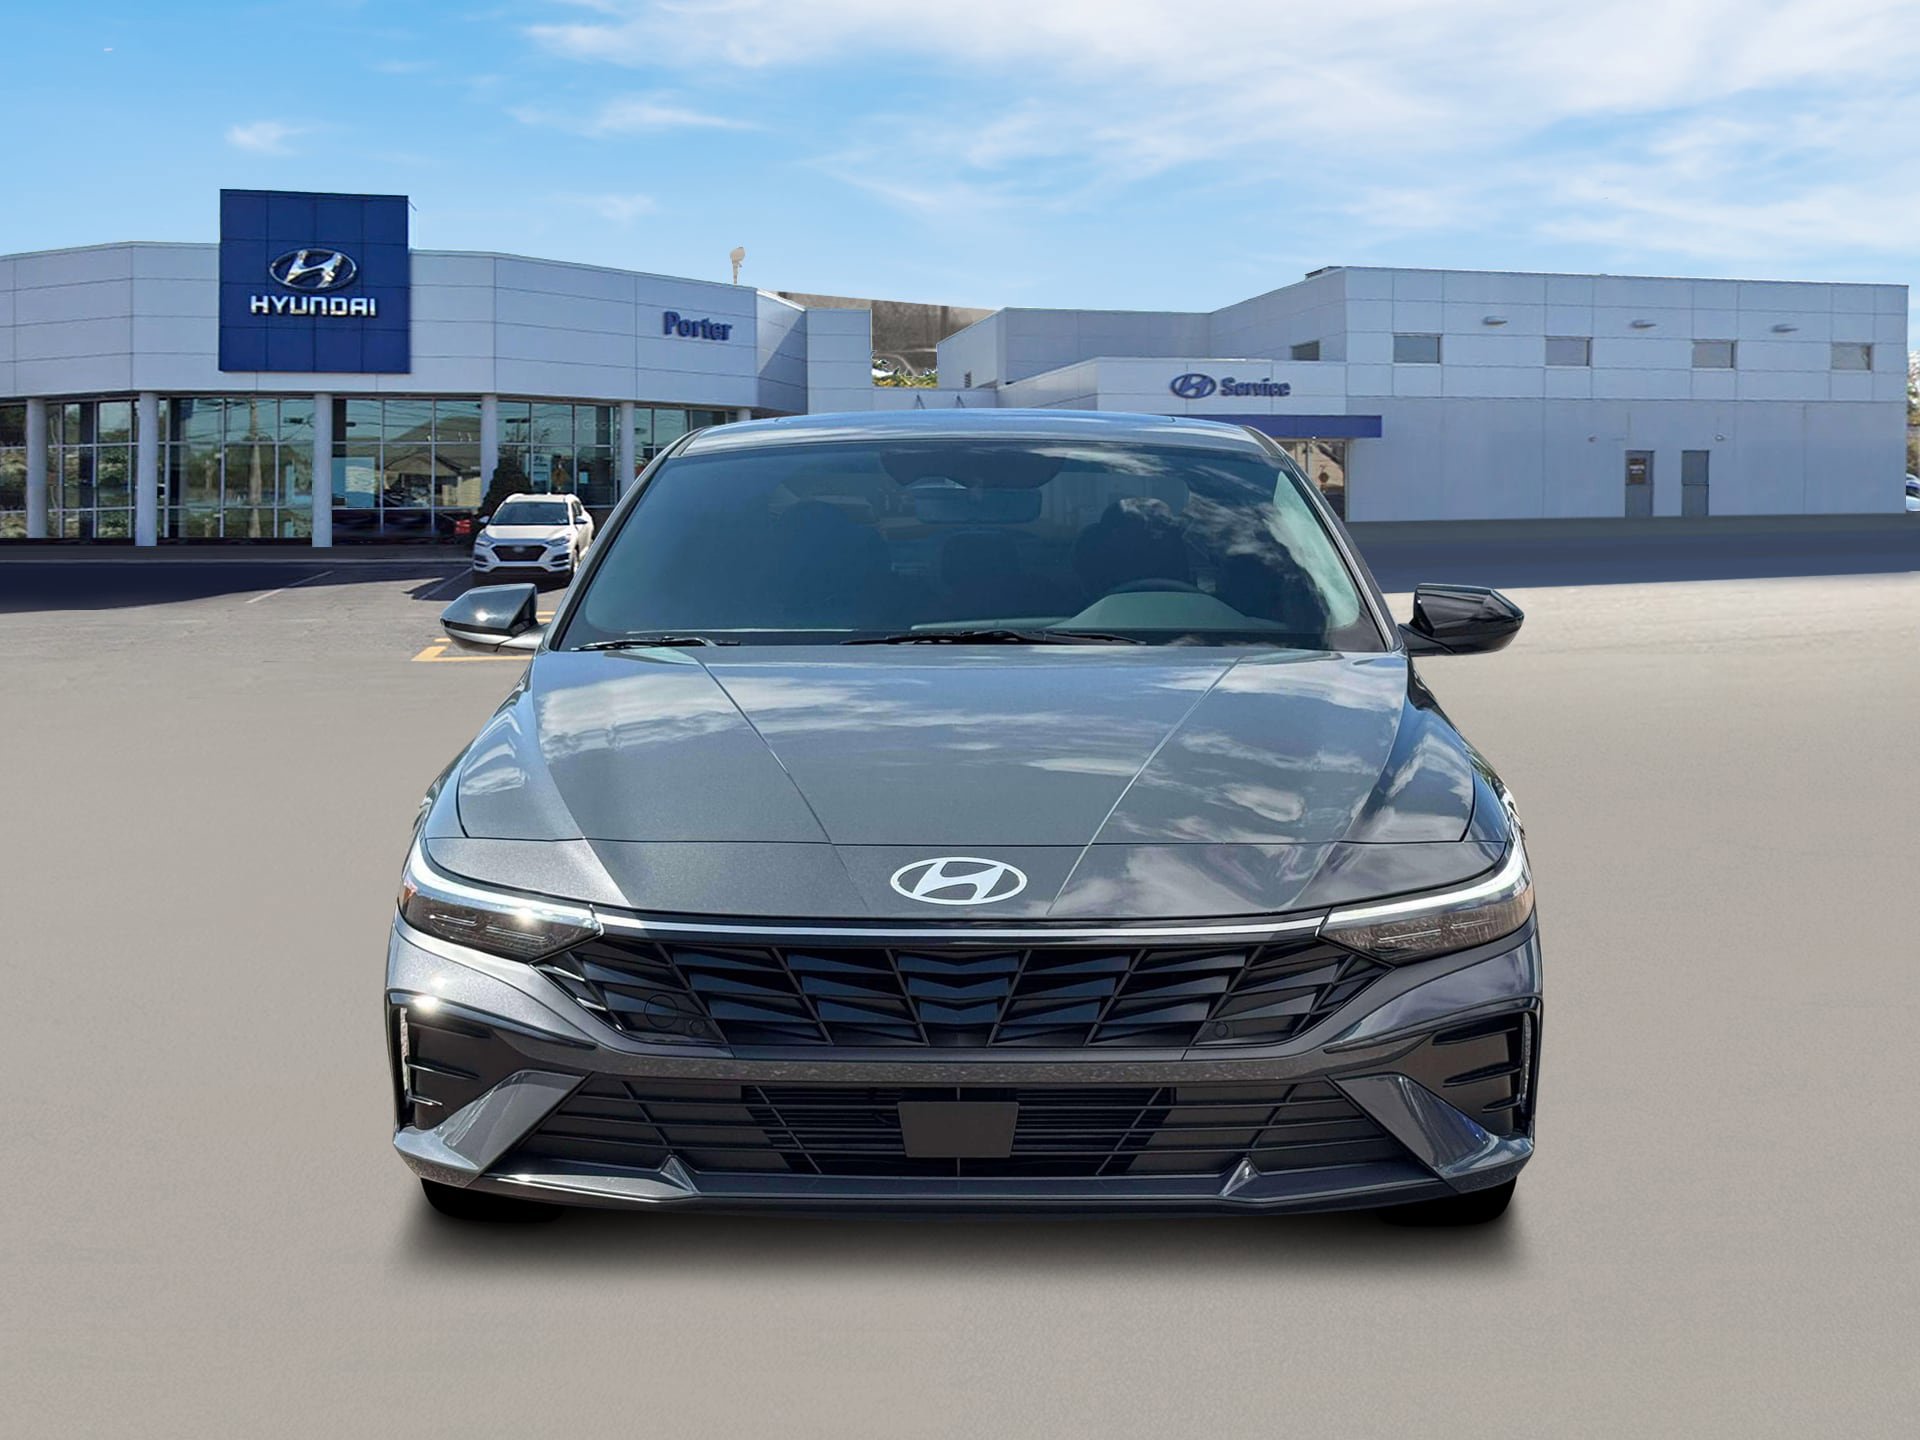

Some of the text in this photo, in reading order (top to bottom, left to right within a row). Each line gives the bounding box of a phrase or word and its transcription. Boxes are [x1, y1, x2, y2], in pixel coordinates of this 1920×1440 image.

[250, 295, 377, 316] HYUNDAI
[663, 311, 733, 341] Porter
[1220, 377, 1291, 397] Service
